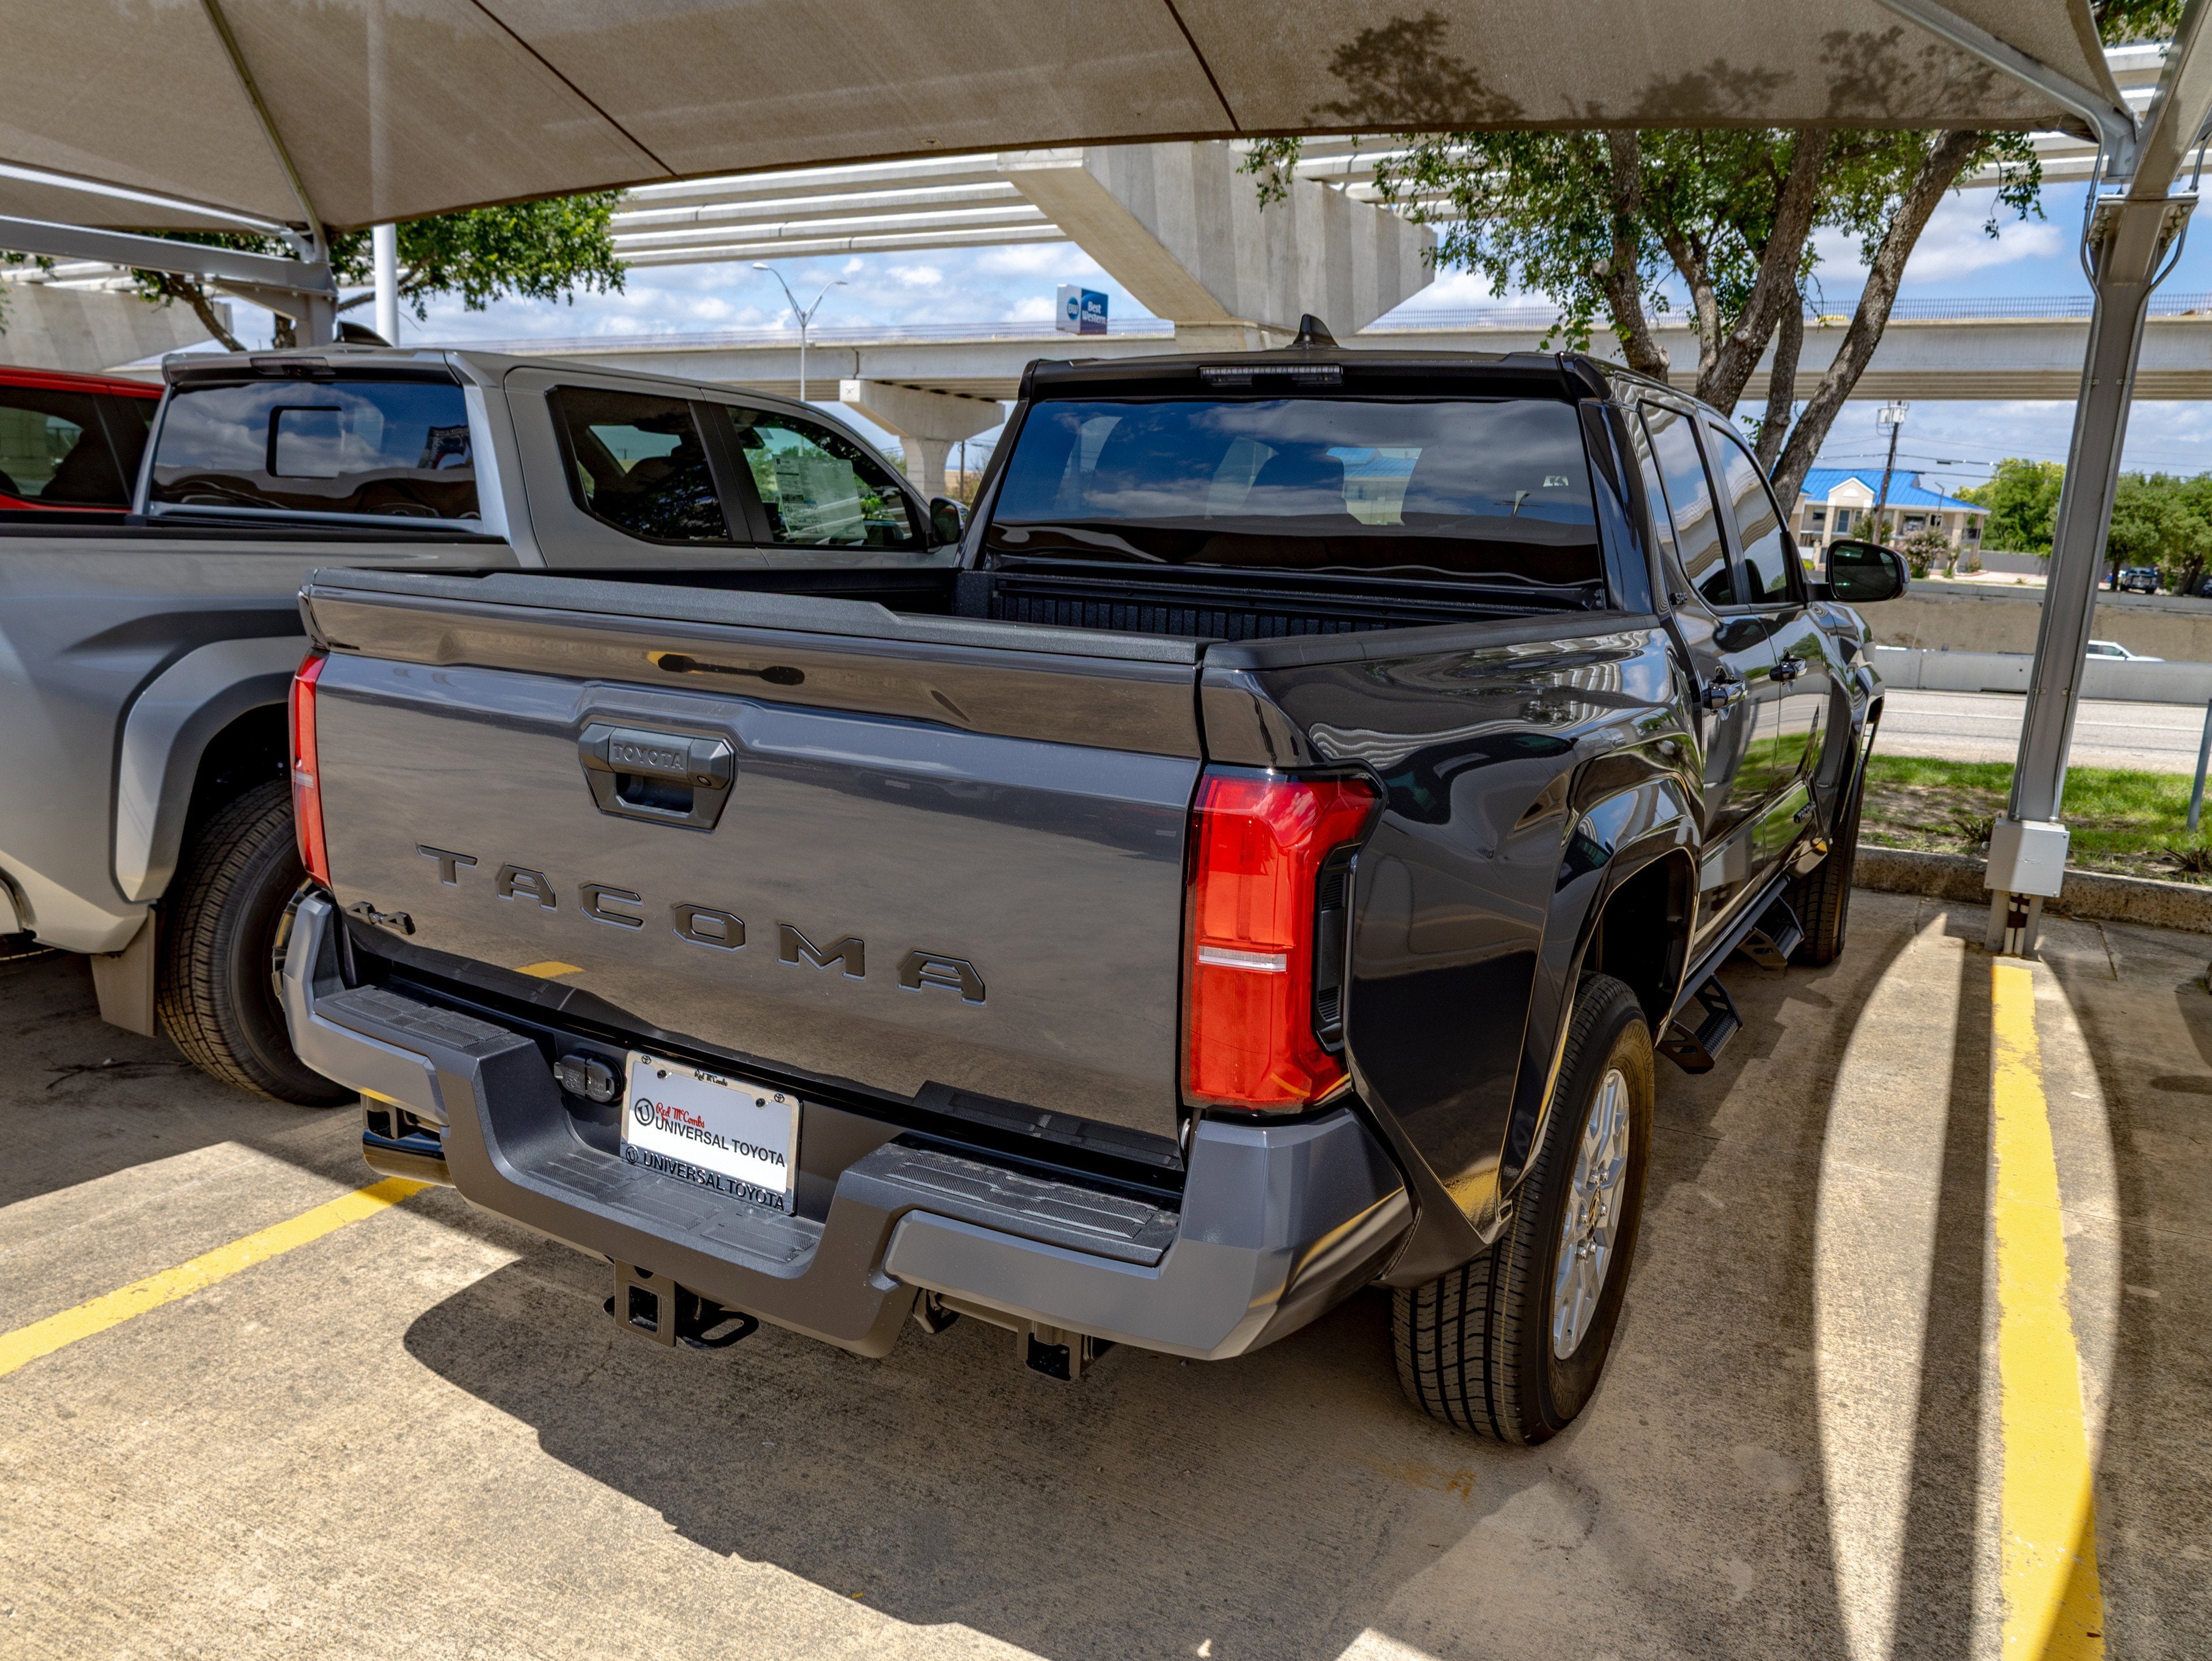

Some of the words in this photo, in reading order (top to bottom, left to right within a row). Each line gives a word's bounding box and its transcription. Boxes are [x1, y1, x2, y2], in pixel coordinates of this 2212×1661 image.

[1081, 310, 1106, 324] Western
[1088, 301, 1101, 314] Best
[612, 743, 684, 770] TOYOTA
[415, 842, 988, 1007] TACOMA
[694, 1069, 704, 1081] Red
[656, 1102, 671, 1121] Red
[672, 1106, 705, 1129] McCombs
[655, 1116, 729, 1151] UNIVERSAL
[731, 1138, 786, 1168] TOYOTA
[643, 1151, 725, 1192] UNIVERSAL
[725, 1178, 785, 1211] TOYOTA
